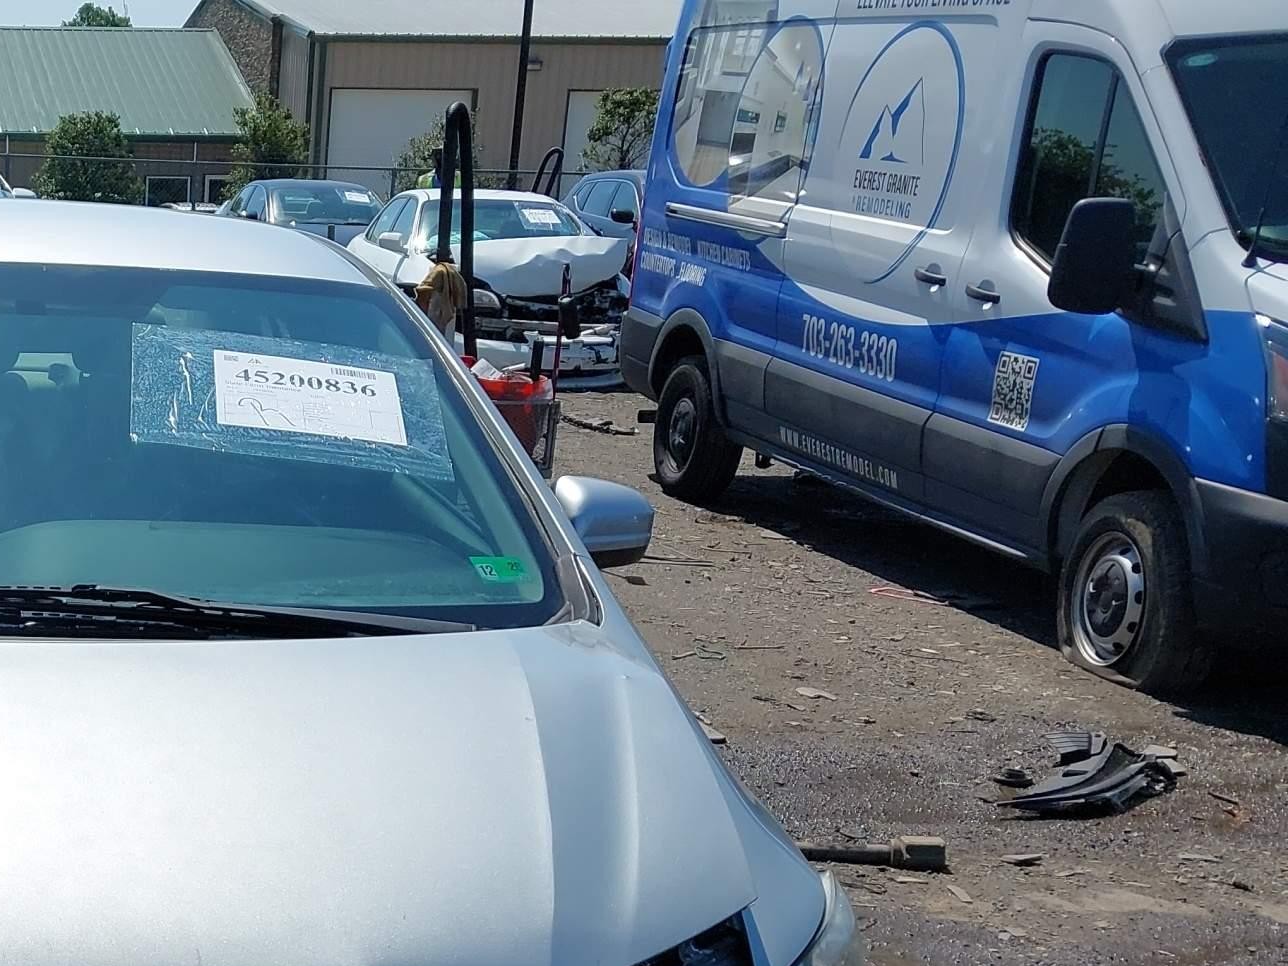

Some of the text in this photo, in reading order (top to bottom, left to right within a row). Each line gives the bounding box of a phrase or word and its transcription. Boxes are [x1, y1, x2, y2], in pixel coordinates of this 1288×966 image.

[853, 169, 921, 197] EVEREST GRANITE
[855, 195, 912, 219] REMODELING
[679, 261, 708, 287] FLOORING
[801, 313, 898, 383] 703-263-3330
[234, 368, 377, 398] 45200836
[779, 425, 899, 490] WWW.EVERESTREMODEL.COM
[480, 564, 497, 577] 12
